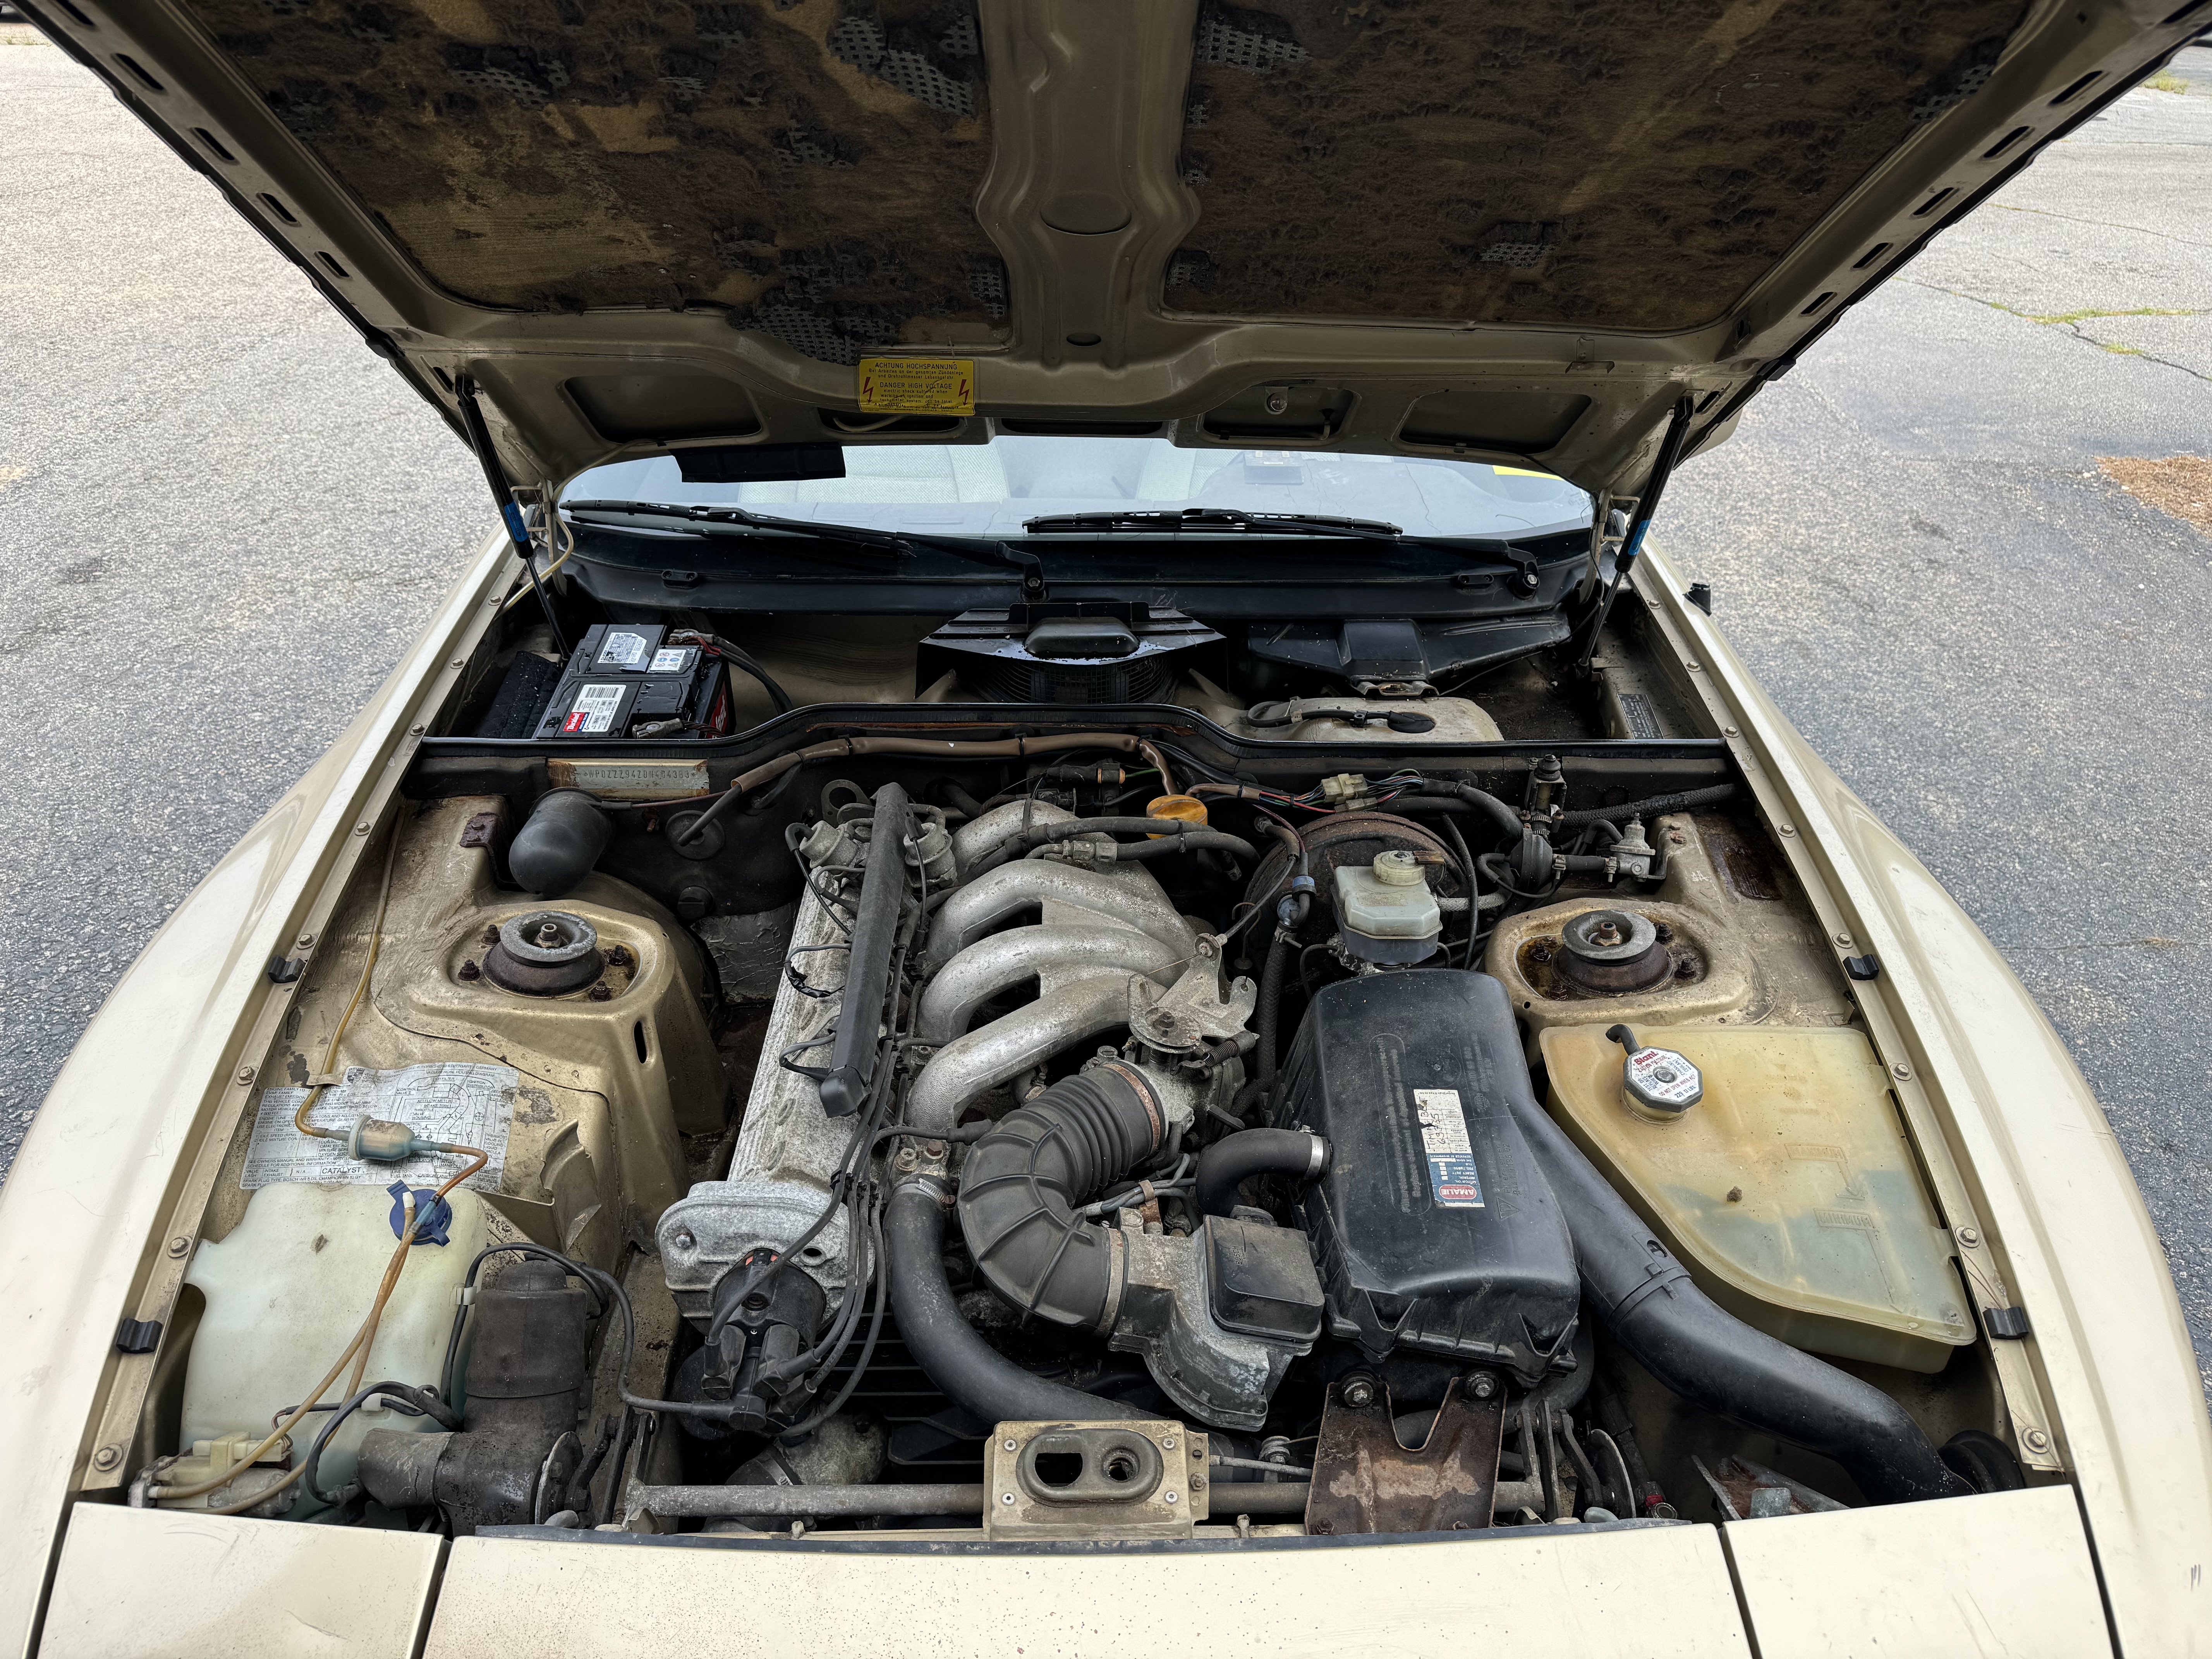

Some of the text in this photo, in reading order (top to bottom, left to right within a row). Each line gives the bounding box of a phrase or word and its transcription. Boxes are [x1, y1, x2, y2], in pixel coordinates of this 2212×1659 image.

[1395, 1083, 1409, 1117] specified
[1404, 1130, 1415, 1162] element
[1503, 1144, 1511, 1152] 02
[1505, 1155, 1514, 1166] 186
[1408, 1164, 1421, 1197] Replace
[1819, 1212, 1872, 1227] MINIMUM
[1232, 1246, 1242, 1266] BOSCH
